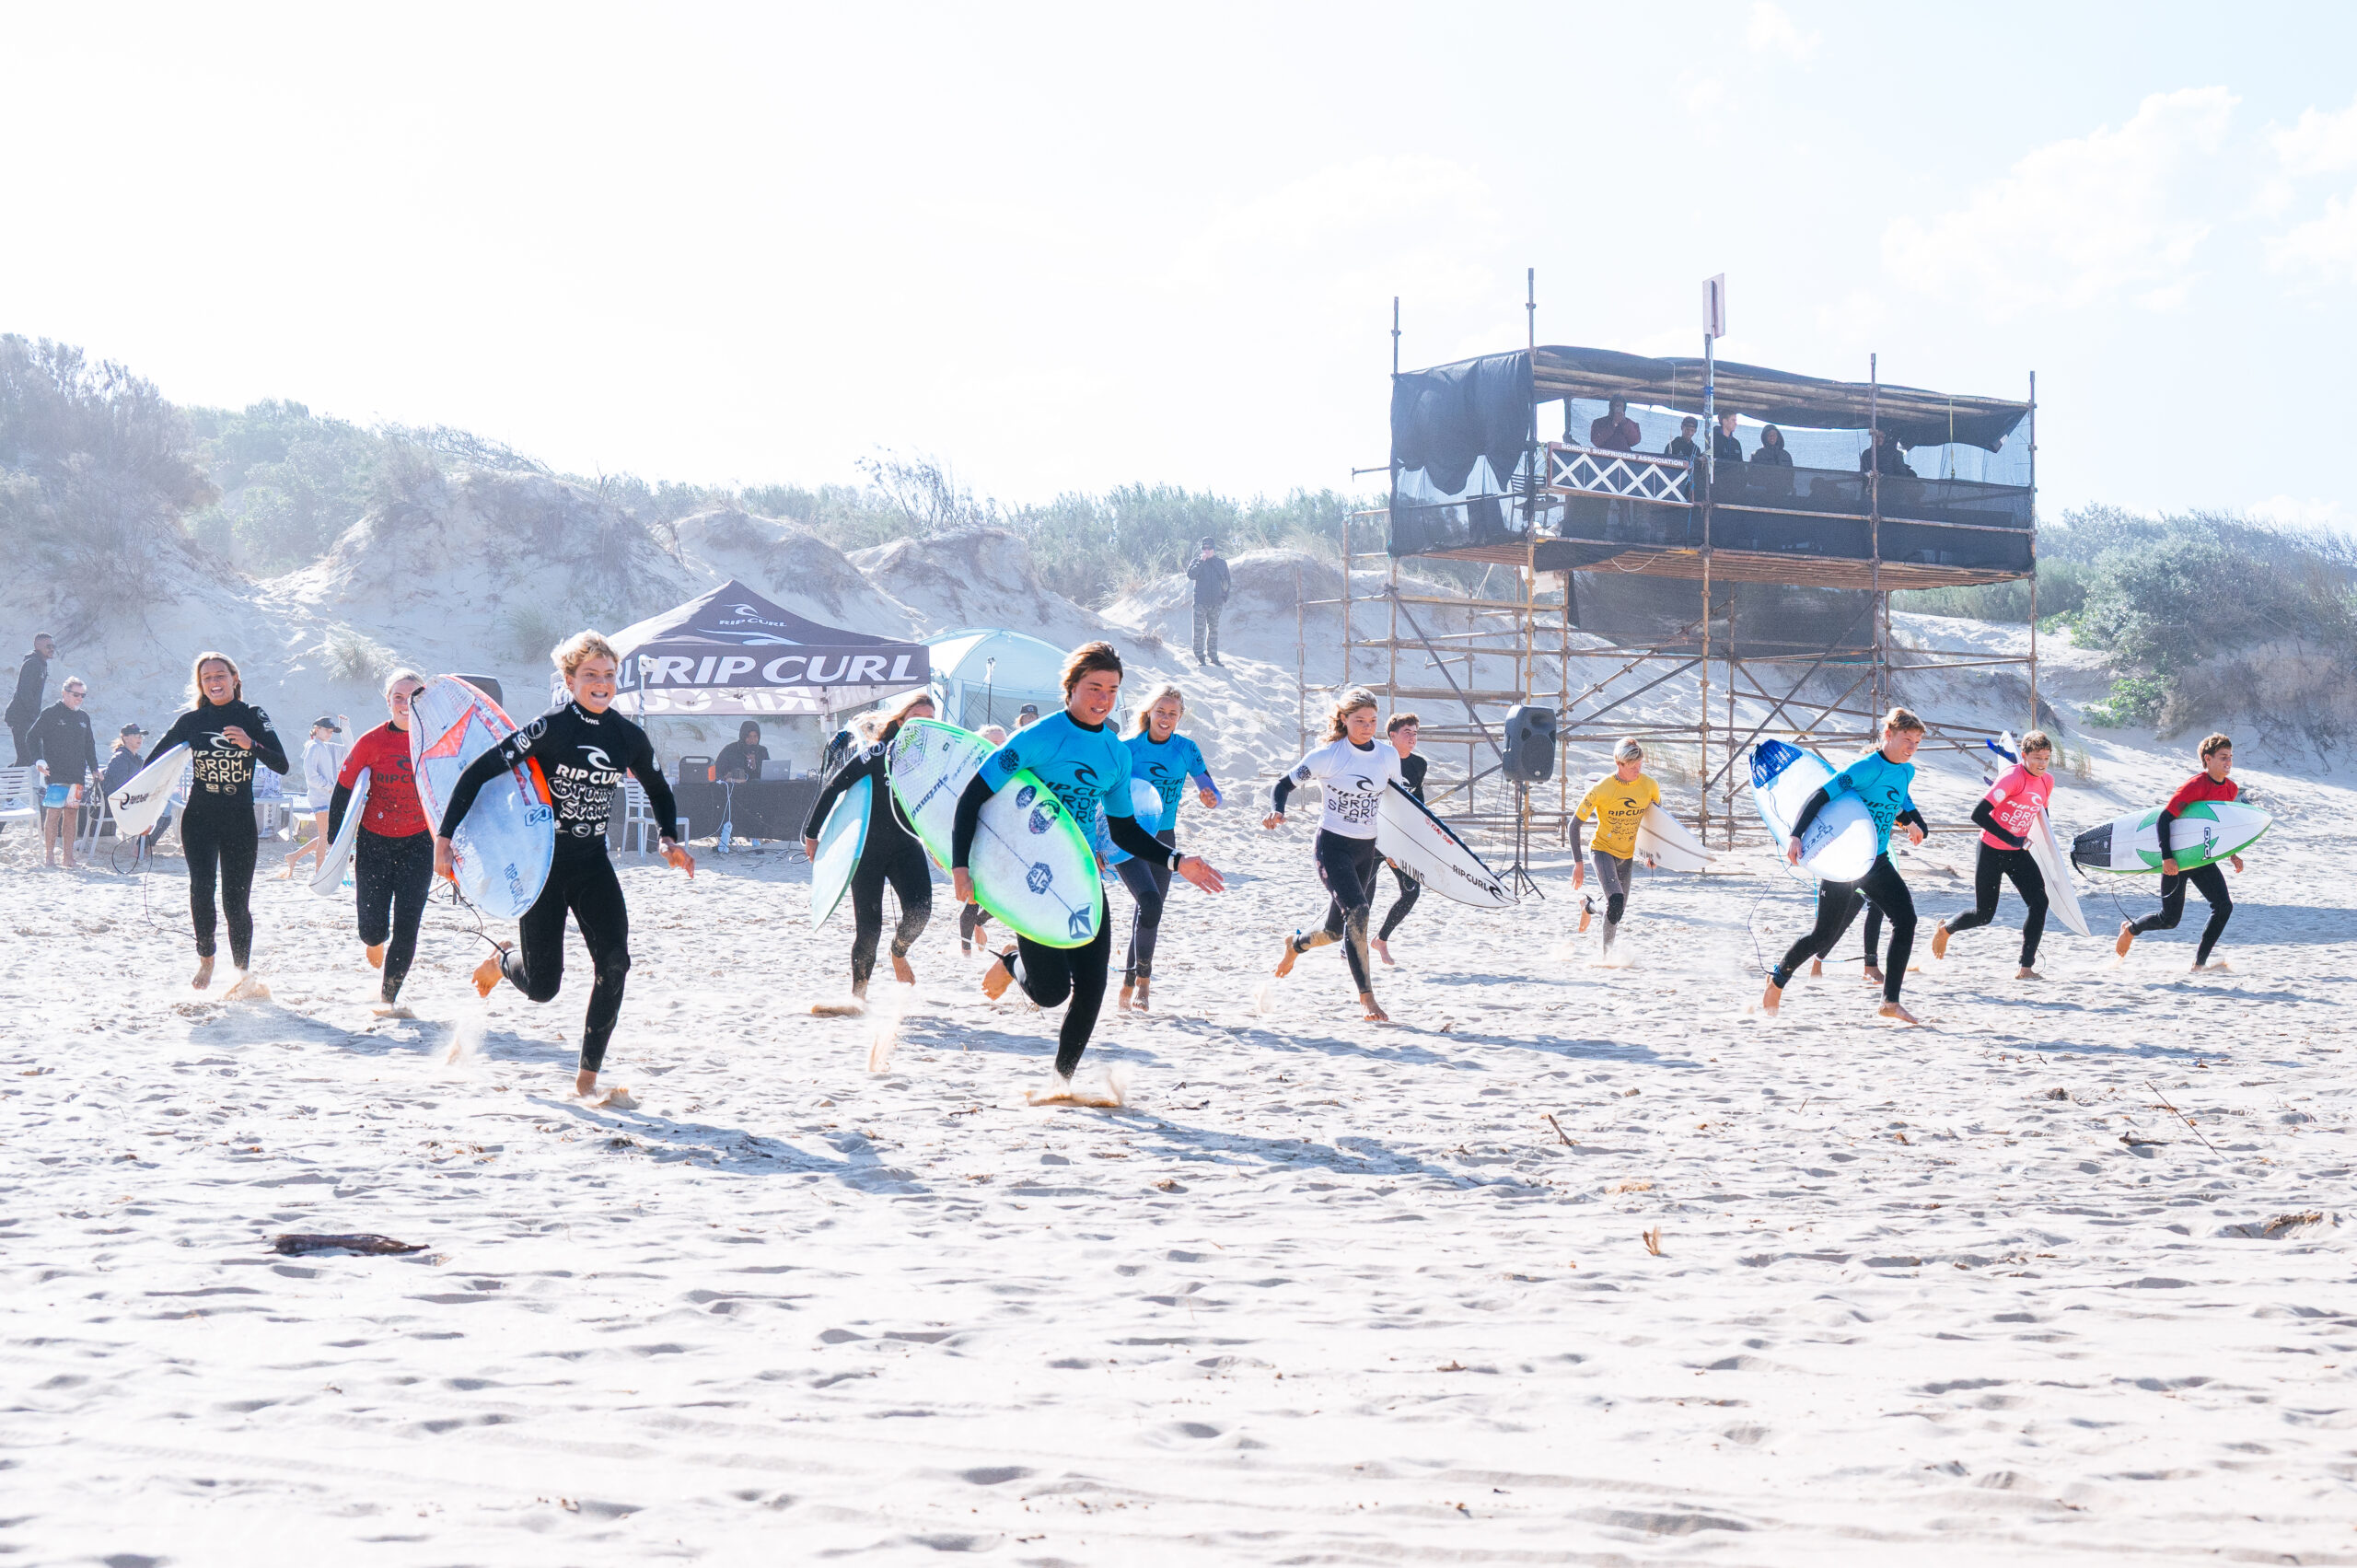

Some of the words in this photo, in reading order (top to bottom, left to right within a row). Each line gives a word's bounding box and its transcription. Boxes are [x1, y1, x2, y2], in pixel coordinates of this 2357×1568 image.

[1562, 444, 1591, 453] BORDER
[1592, 447, 1636, 459] SURFRIDERS
[1638, 454, 1684, 467] ASSOCIATION
[748, 618, 787, 626] CURL
[649, 656, 756, 683] RIP
[762, 655, 918, 683] CURL
[195, 759, 242, 771] GROM
[555, 763, 588, 781] RIP
[589, 772, 622, 784] CUR
[194, 767, 251, 783] SEARCH
[377, 773, 399, 784] RIP
[1327, 784, 1354, 797] RIP
[1328, 798, 1377, 818] SEARC
[504, 863, 517, 881] RIP
[1453, 865, 1466, 877] RIP
[1466, 874, 1489, 892] CURL
[509, 877, 525, 905] CURL
